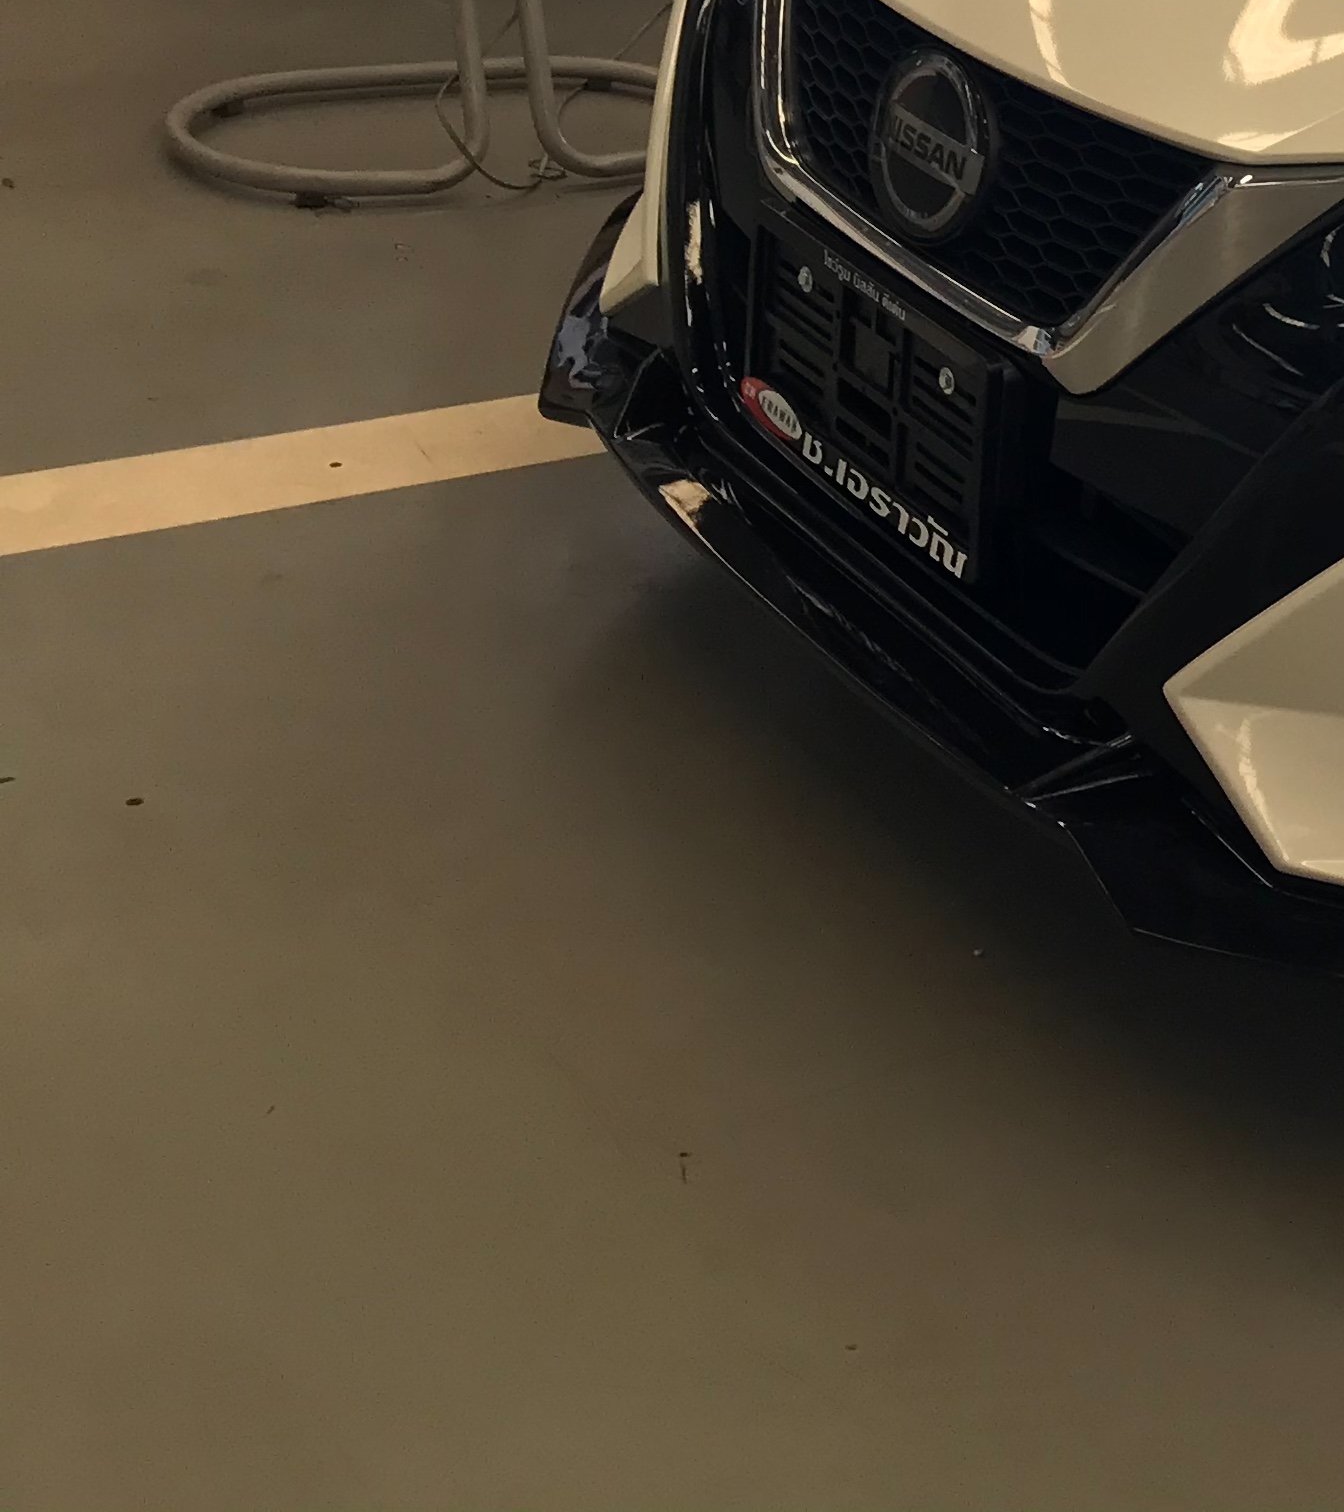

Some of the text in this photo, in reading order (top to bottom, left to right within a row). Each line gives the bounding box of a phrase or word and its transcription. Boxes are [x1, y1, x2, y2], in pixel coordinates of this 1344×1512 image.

[887, 111, 968, 182] NISSAN
[801, 431, 969, 579] ช.เอราวัณ
